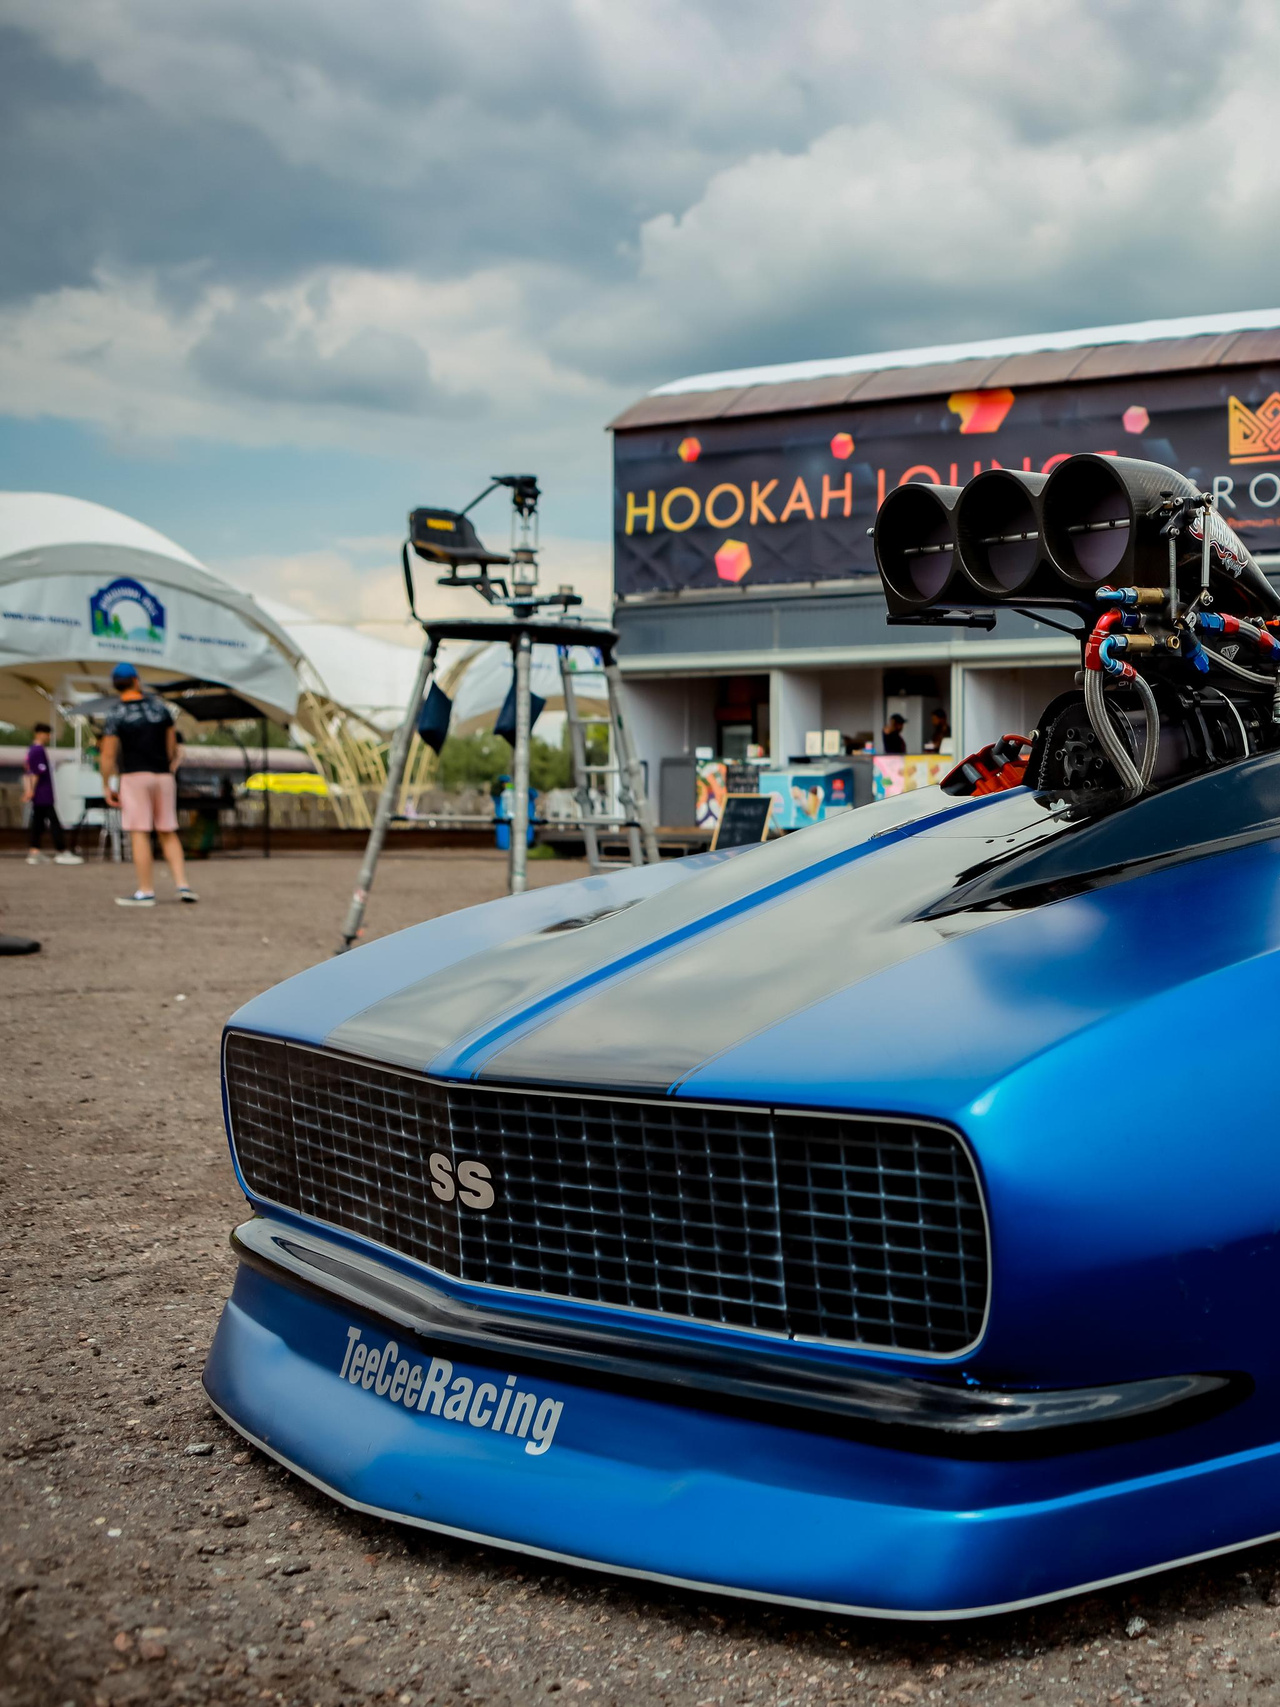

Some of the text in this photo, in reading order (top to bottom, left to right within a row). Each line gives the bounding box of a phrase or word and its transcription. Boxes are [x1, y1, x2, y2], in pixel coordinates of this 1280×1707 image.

[625, 472, 852, 535] HOOKAH
[429, 1152, 494, 1209] SS
[339, 1325, 564, 1455] TeeCeeRacing
